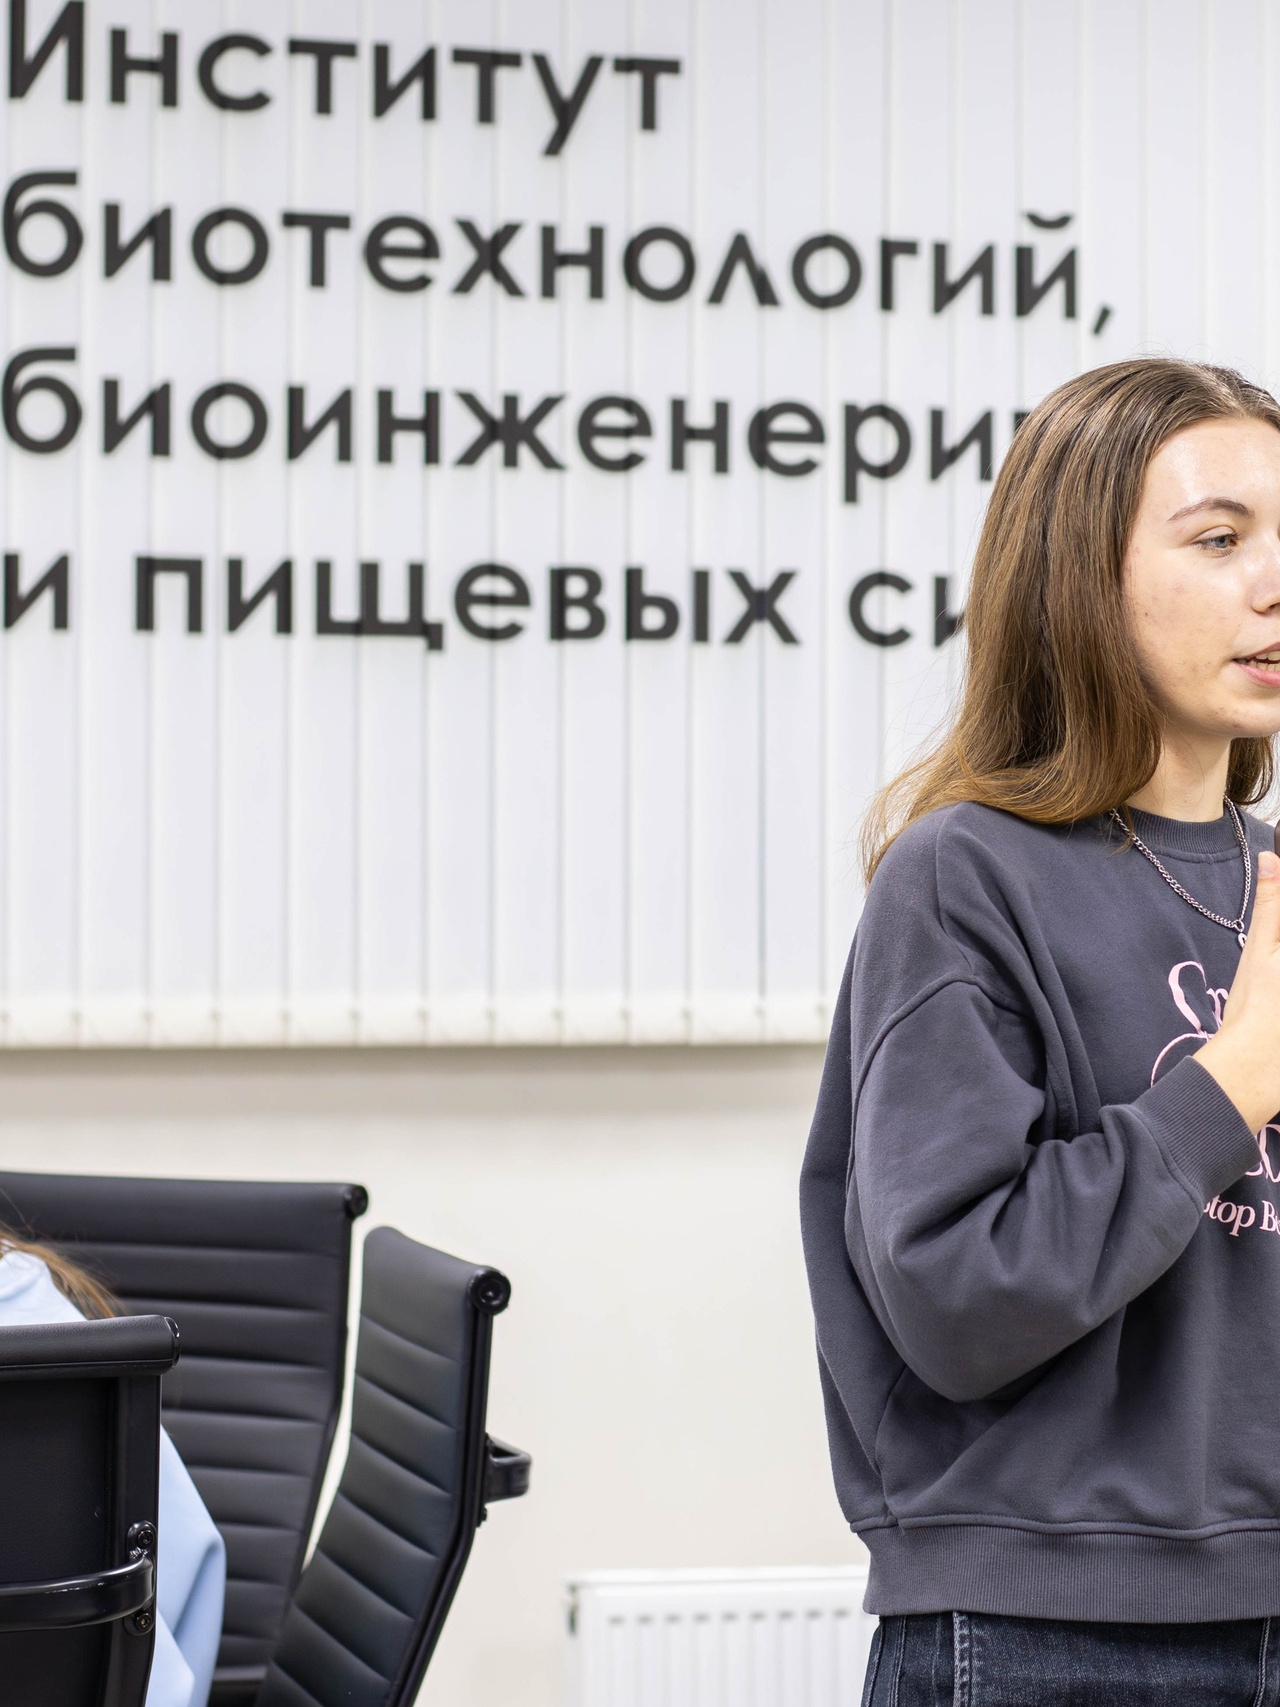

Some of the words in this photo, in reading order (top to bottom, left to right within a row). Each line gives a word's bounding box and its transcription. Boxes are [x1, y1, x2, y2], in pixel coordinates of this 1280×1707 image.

[6, 0, 682, 157] Институт
[3, 170, 1113, 336] биотехнологий,
[3, 347, 1040, 502] биоинженери
[2, 552, 70, 632] и
[134, 555, 798, 651] пищевых
